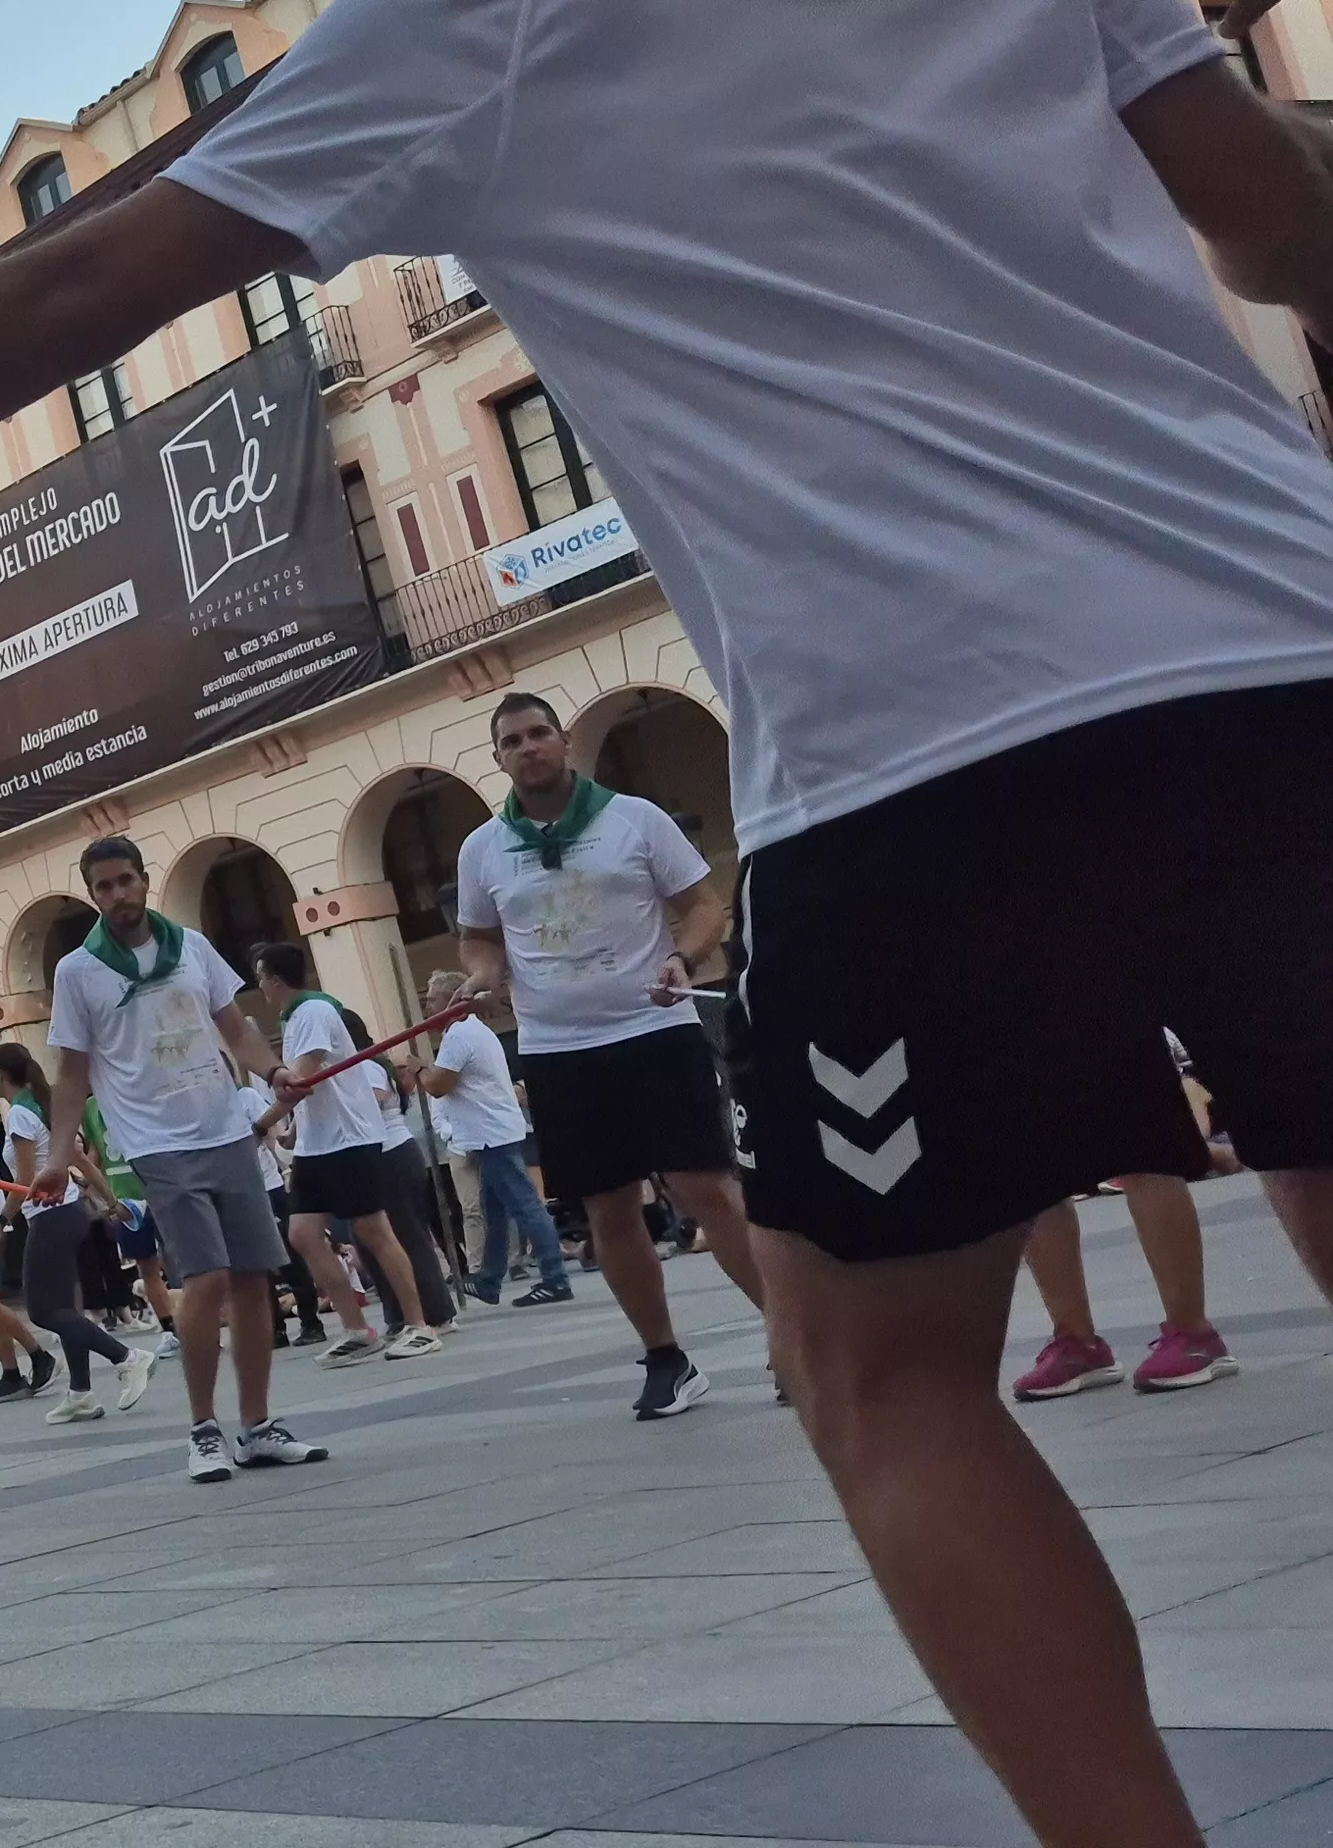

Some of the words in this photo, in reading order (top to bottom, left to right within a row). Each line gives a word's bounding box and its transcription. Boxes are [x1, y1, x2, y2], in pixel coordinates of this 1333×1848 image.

[25, 491, 121, 567] MERCADO
[531, 517, 622, 568] Rivatec
[44, 591, 129, 652] APERTURA
[189, 565, 301, 622] ALOJAMIENTOS
[191, 580, 305, 637] DIFERENTES
[202, 631, 336, 697] gestion@tribonaventure.es
[240, 637, 260, 656] 629
[260, 629, 279, 648] 345
[279, 621, 299, 639] 793
[194, 645, 358, 720] www.alojamientosdiferentes.com
[20, 708, 99, 754] Alojamiento
[31, 769, 42, 786] y
[42, 750, 84, 780] media
[86, 724, 148, 762] estancia
